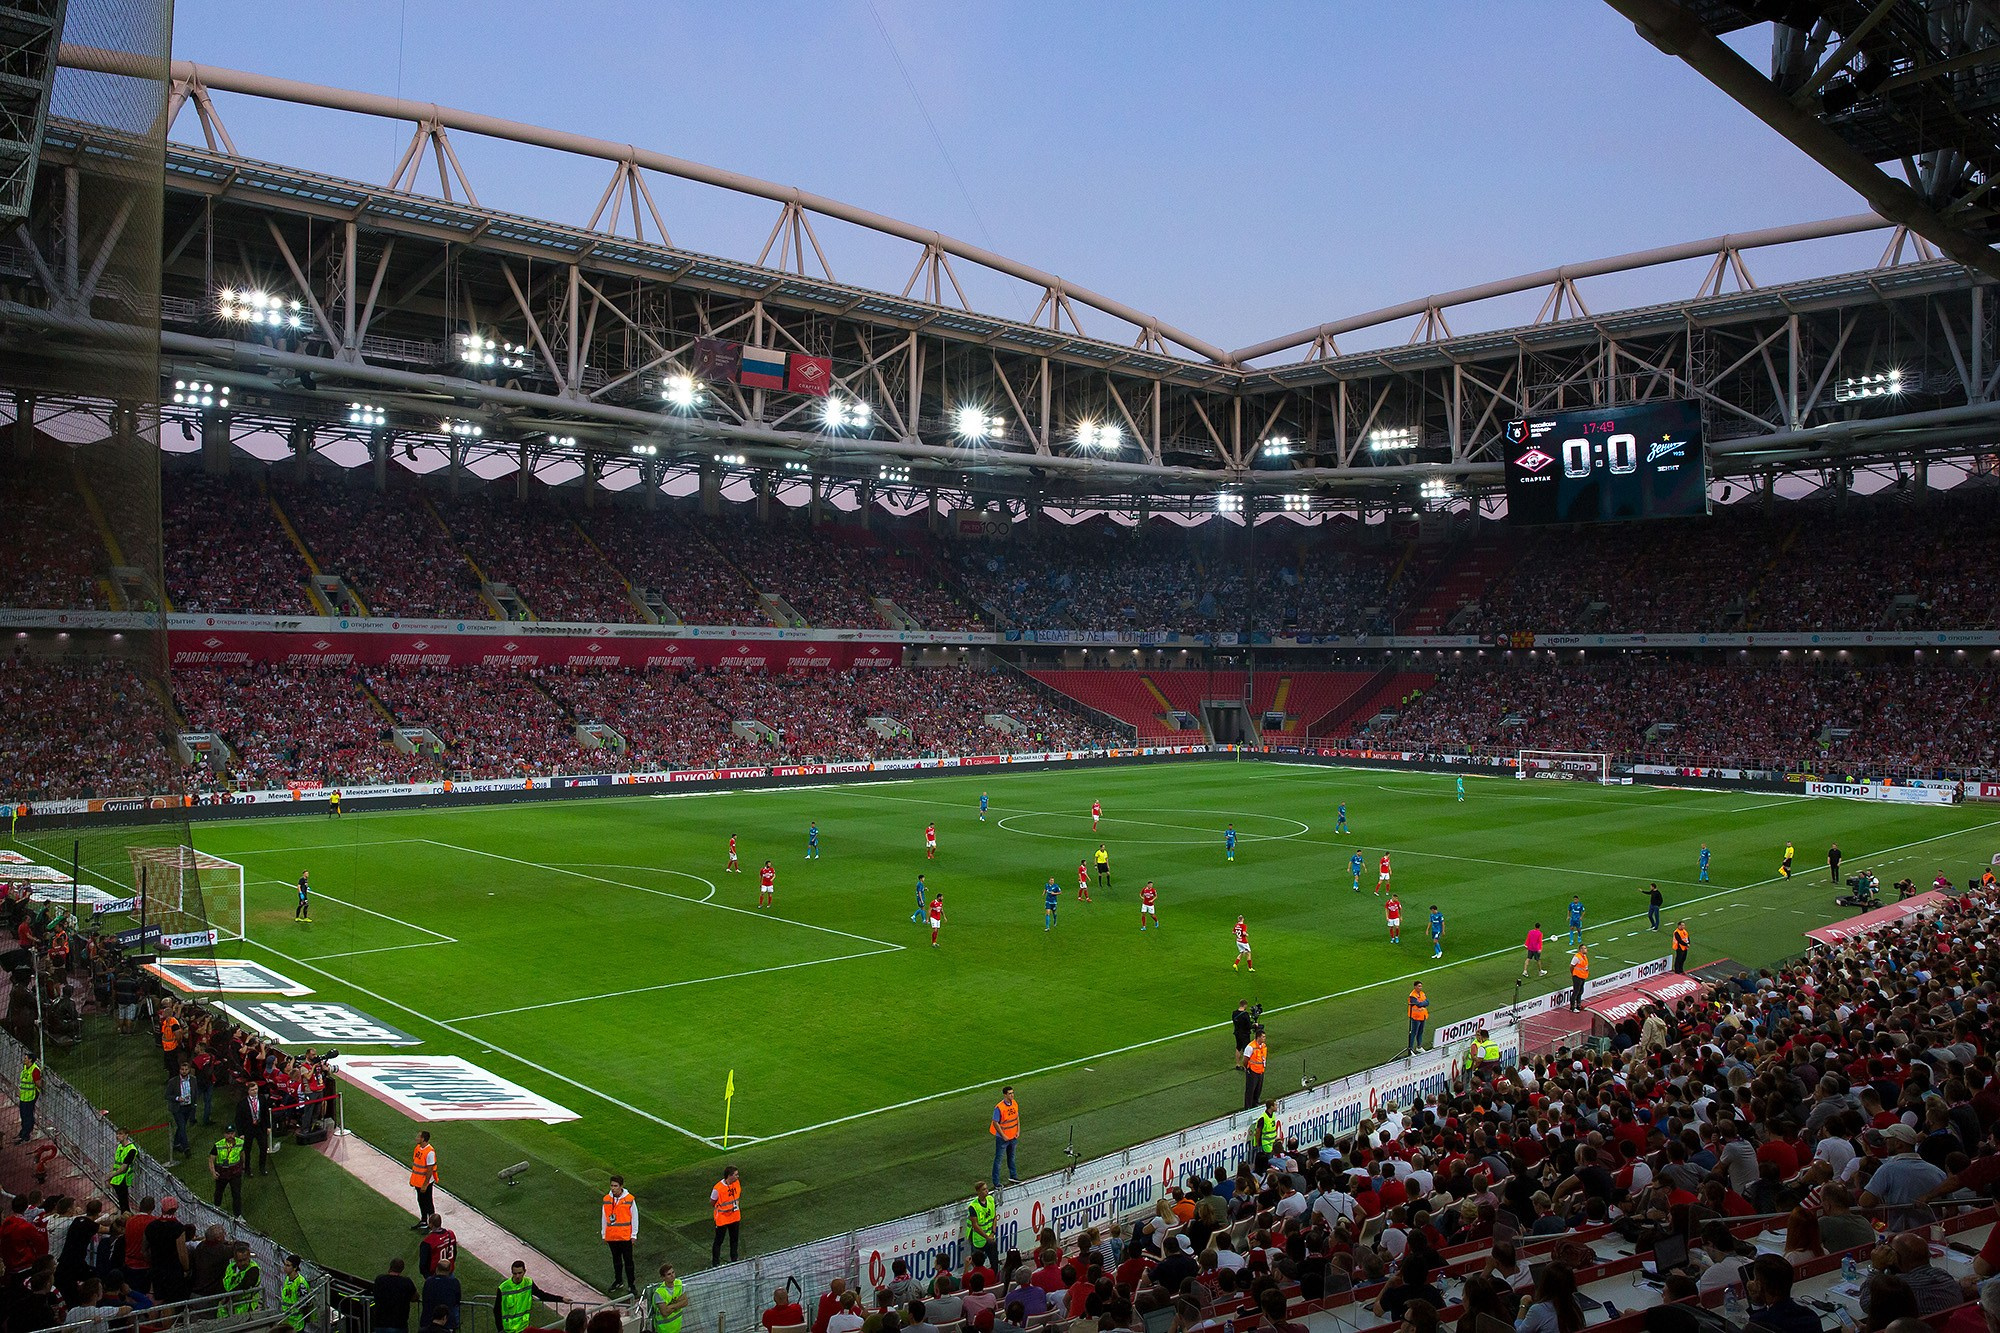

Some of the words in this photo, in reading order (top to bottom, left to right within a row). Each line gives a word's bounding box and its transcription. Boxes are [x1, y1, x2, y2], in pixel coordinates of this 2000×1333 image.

[1583, 421, 1615, 434] 17:49
[1520, 475, 1551, 483] СПАРТАК
[216, 619, 249, 627] открытие
[350, 621, 384, 629] открытие
[467, 624, 497, 632] открытие
[1548, 637, 1580, 645] НФПРиР
[174, 652, 249, 664] SPARTAK-MOSCOW
[287, 653, 354, 665] SPARTAK-MOSCOW
[389, 653, 451, 665] SPARTAK-MOSCOW
[482, 654, 539, 666] SPARTAK-MOSCOW
[568, 655, 620, 666] SPARTAK-MOSCOW
[720, 656, 766, 666] SPARTAK-MOSCOW
[788, 657, 831, 667] SPARTAK-MOSCOW
[853, 657, 893, 667] SPARTAK-MOSCOW
[831, 766, 869, 776] NISSAN
[1534, 771, 1574, 780] GENESIS
[346, 786, 412, 797] Менеджмент-Центр
[462, 784, 471, 793] НА
[475, 784, 491, 793] РЕКЕ
[1812, 784, 1869, 796] НФПРиР
[108, 800, 143, 812] Winlin
[164, 933, 215, 946] НФПРиР
[1638, 960, 1668, 979] НФПРиР
[1654, 980, 1698, 1000] НФПРиР
[1442, 1018, 1485, 1043] НФПРиР
[1420, 1063, 1446, 1077] ХОРОШО
[1381, 1080, 1418, 1112] РУССКОЕ
[1420, 1072, 1446, 1102] РАДИО
[1307, 1104, 1329, 1117] БУДЕТ
[1334, 1091, 1362, 1107] ХОРОШО
[1289, 1112, 1330, 1147] РУССКОЕ
[1333, 1101, 1362, 1136] РАДИО
[1201, 1139, 1226, 1153] БУДЕТ
[1179, 1149, 1228, 1189] РУССКОЕ
[1077, 1179, 1107, 1195] БУДЕТ
[1114, 1164, 1153, 1182] ХОРОШО
[1051, 1189, 1109, 1234] РУССКОЕ
[1112, 1174, 1152, 1215] РАДИО
[927, 1226, 963, 1244] БУДЕТ
